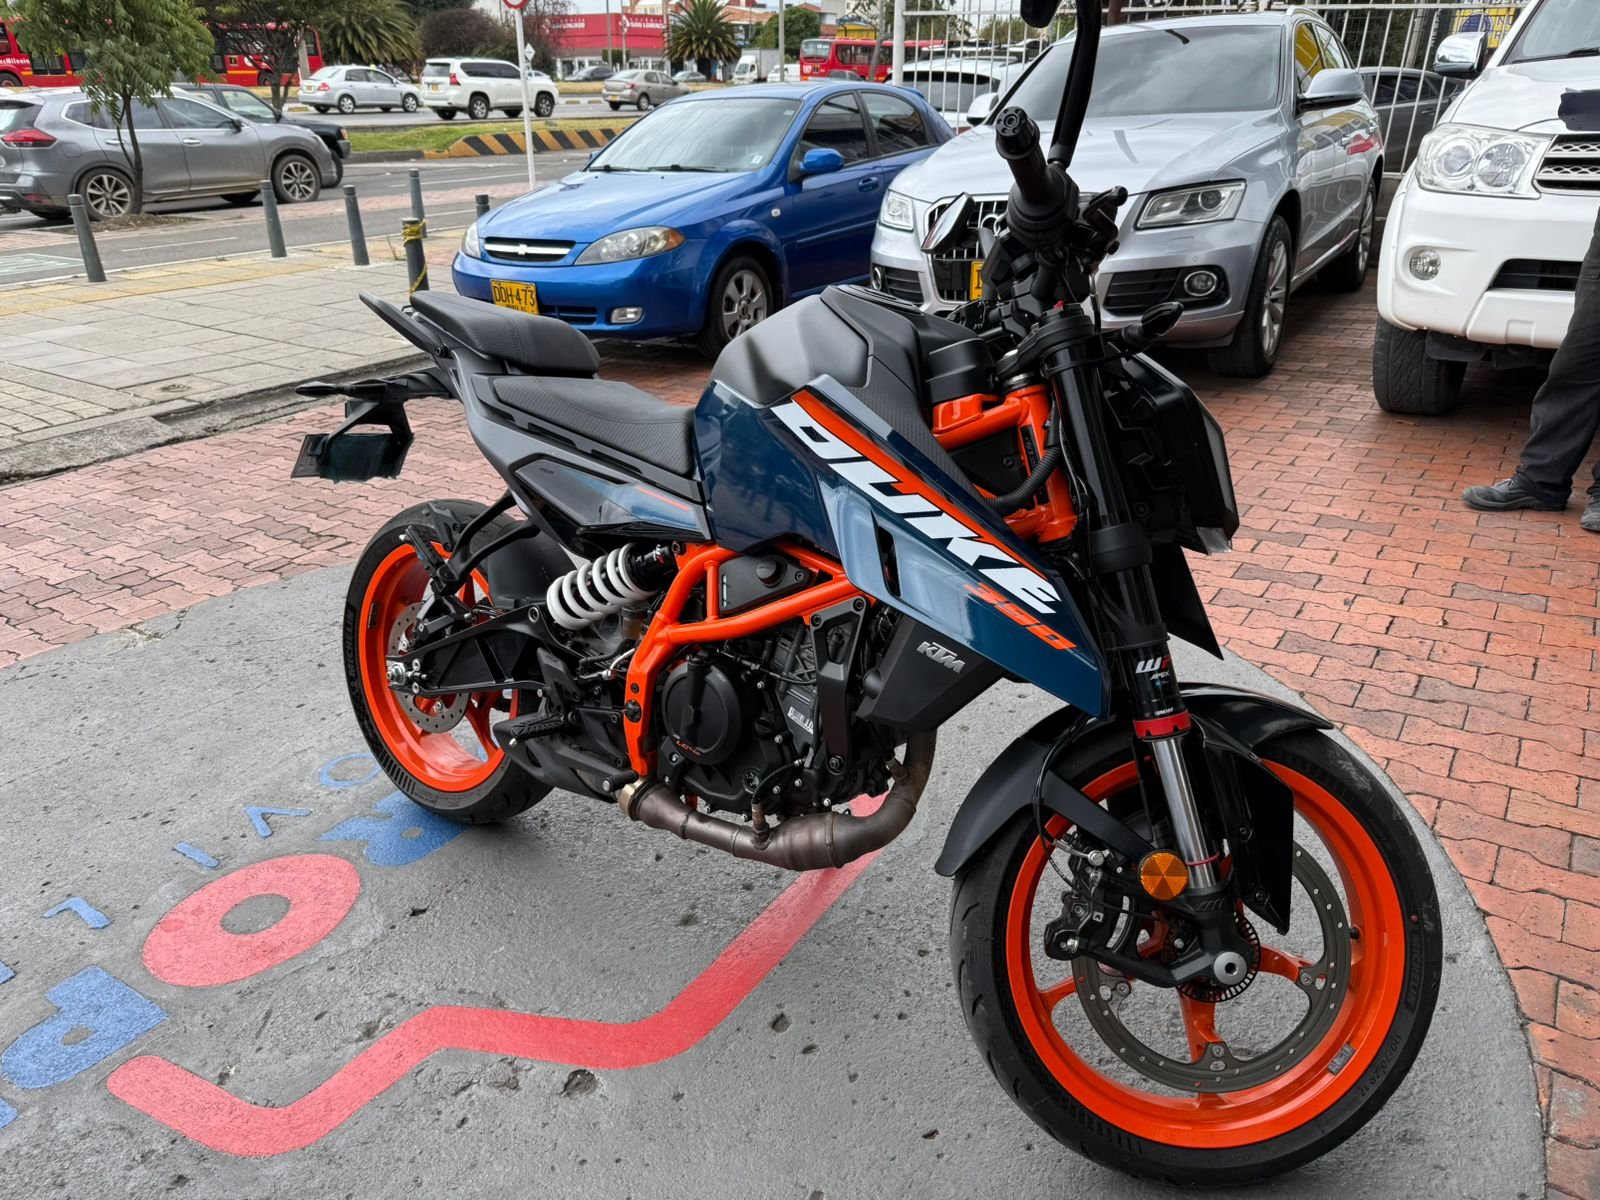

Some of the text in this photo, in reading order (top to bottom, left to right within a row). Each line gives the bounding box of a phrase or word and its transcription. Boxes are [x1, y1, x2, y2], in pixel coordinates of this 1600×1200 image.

[769, 399, 1062, 614] DUKE
[962, 581, 1078, 651] 390
[916, 641, 966, 674] KTM
